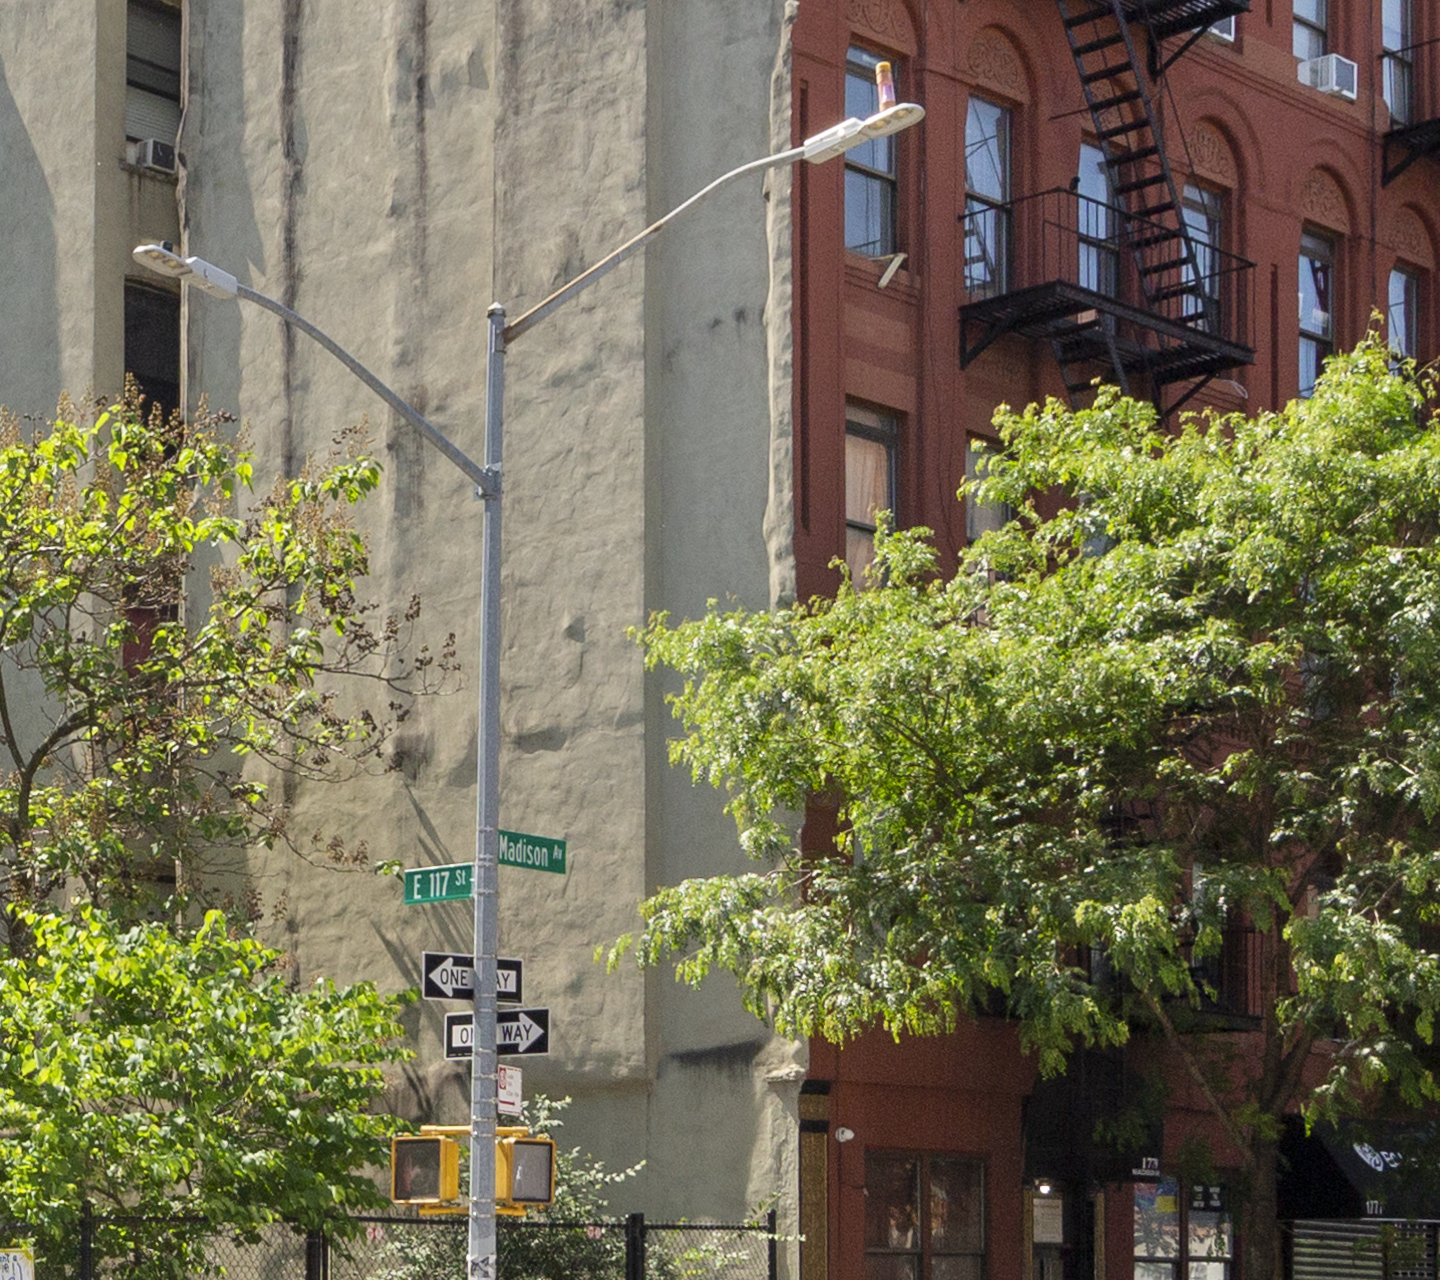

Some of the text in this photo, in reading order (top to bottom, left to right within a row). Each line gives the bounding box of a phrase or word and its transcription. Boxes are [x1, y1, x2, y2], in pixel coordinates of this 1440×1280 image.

[499, 834, 563, 868] Madison Av
[413, 869, 466, 900] E 117 St
[440, 968, 468, 987] ONE
[502, 1023, 533, 1042] WAY
